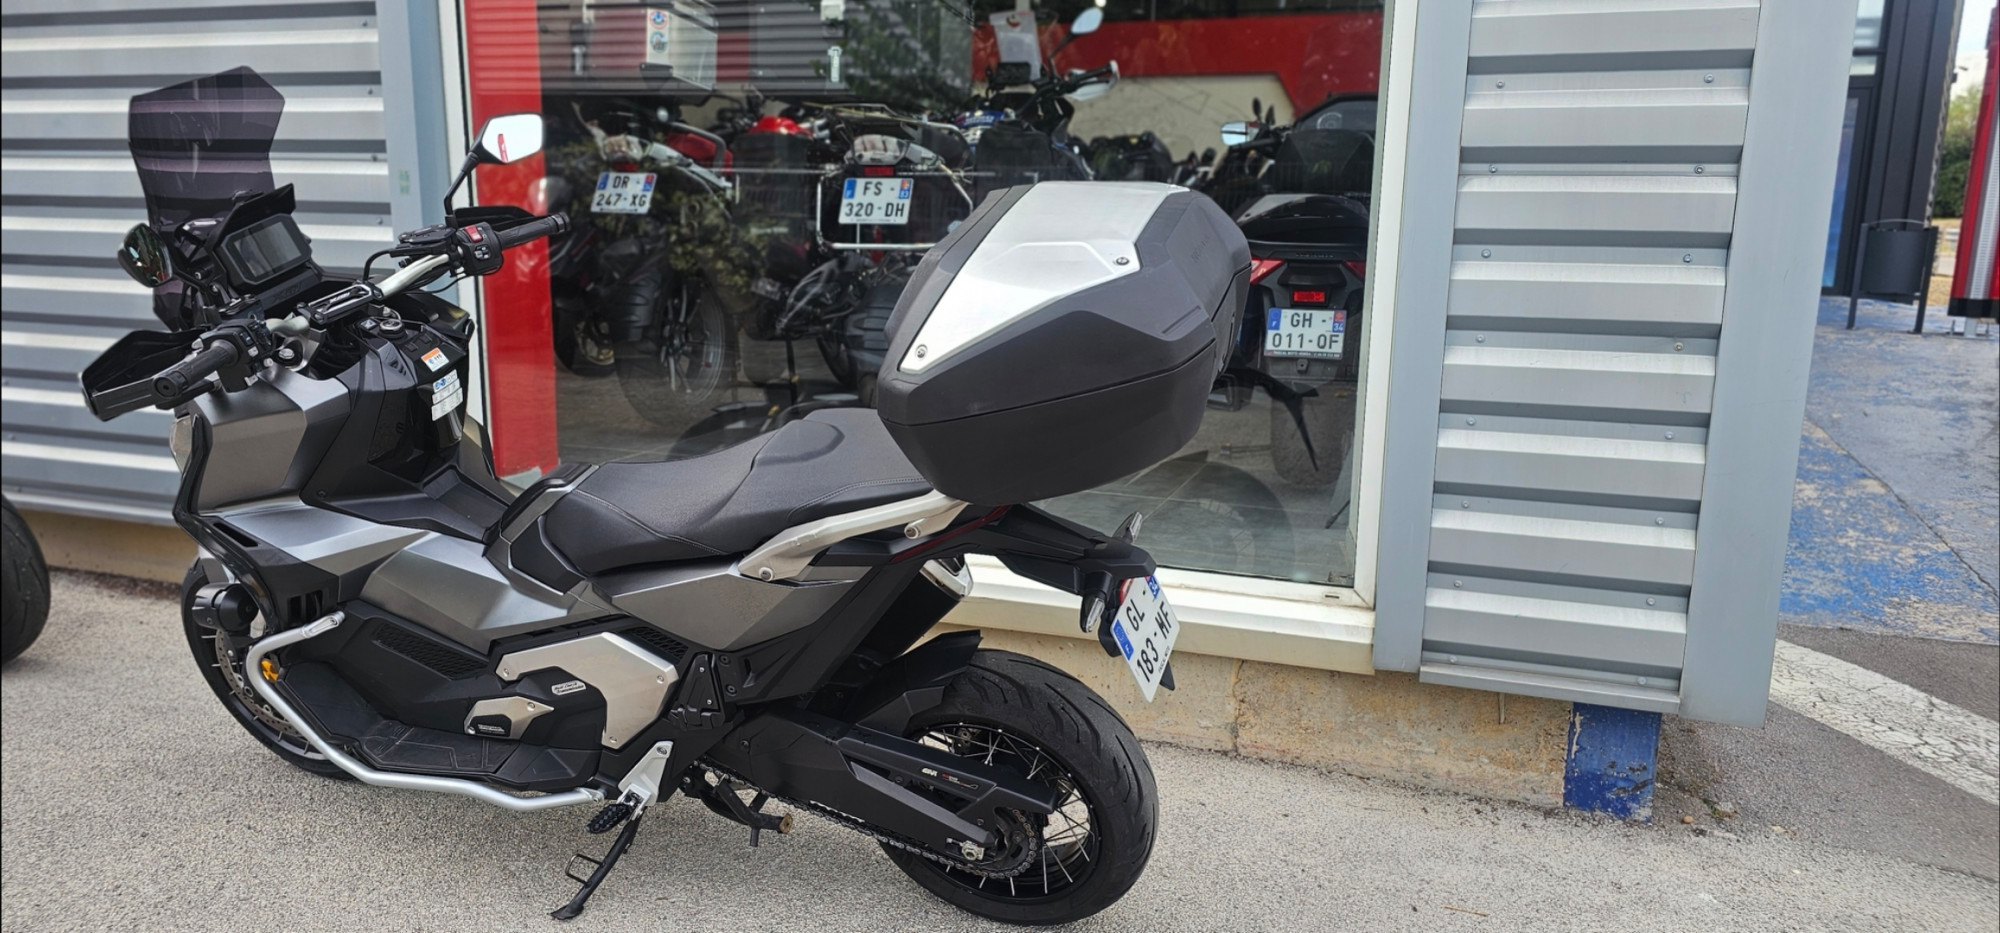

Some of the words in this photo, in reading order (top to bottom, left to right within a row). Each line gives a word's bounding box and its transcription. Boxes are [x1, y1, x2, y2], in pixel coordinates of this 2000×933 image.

[612, 175, 630, 189] DR
[863, 181, 883, 196] FS
[1290, 312, 1313, 328] GH
[1333, 323, 1344, 331] 34
[1126, 599, 1146, 632] GL
